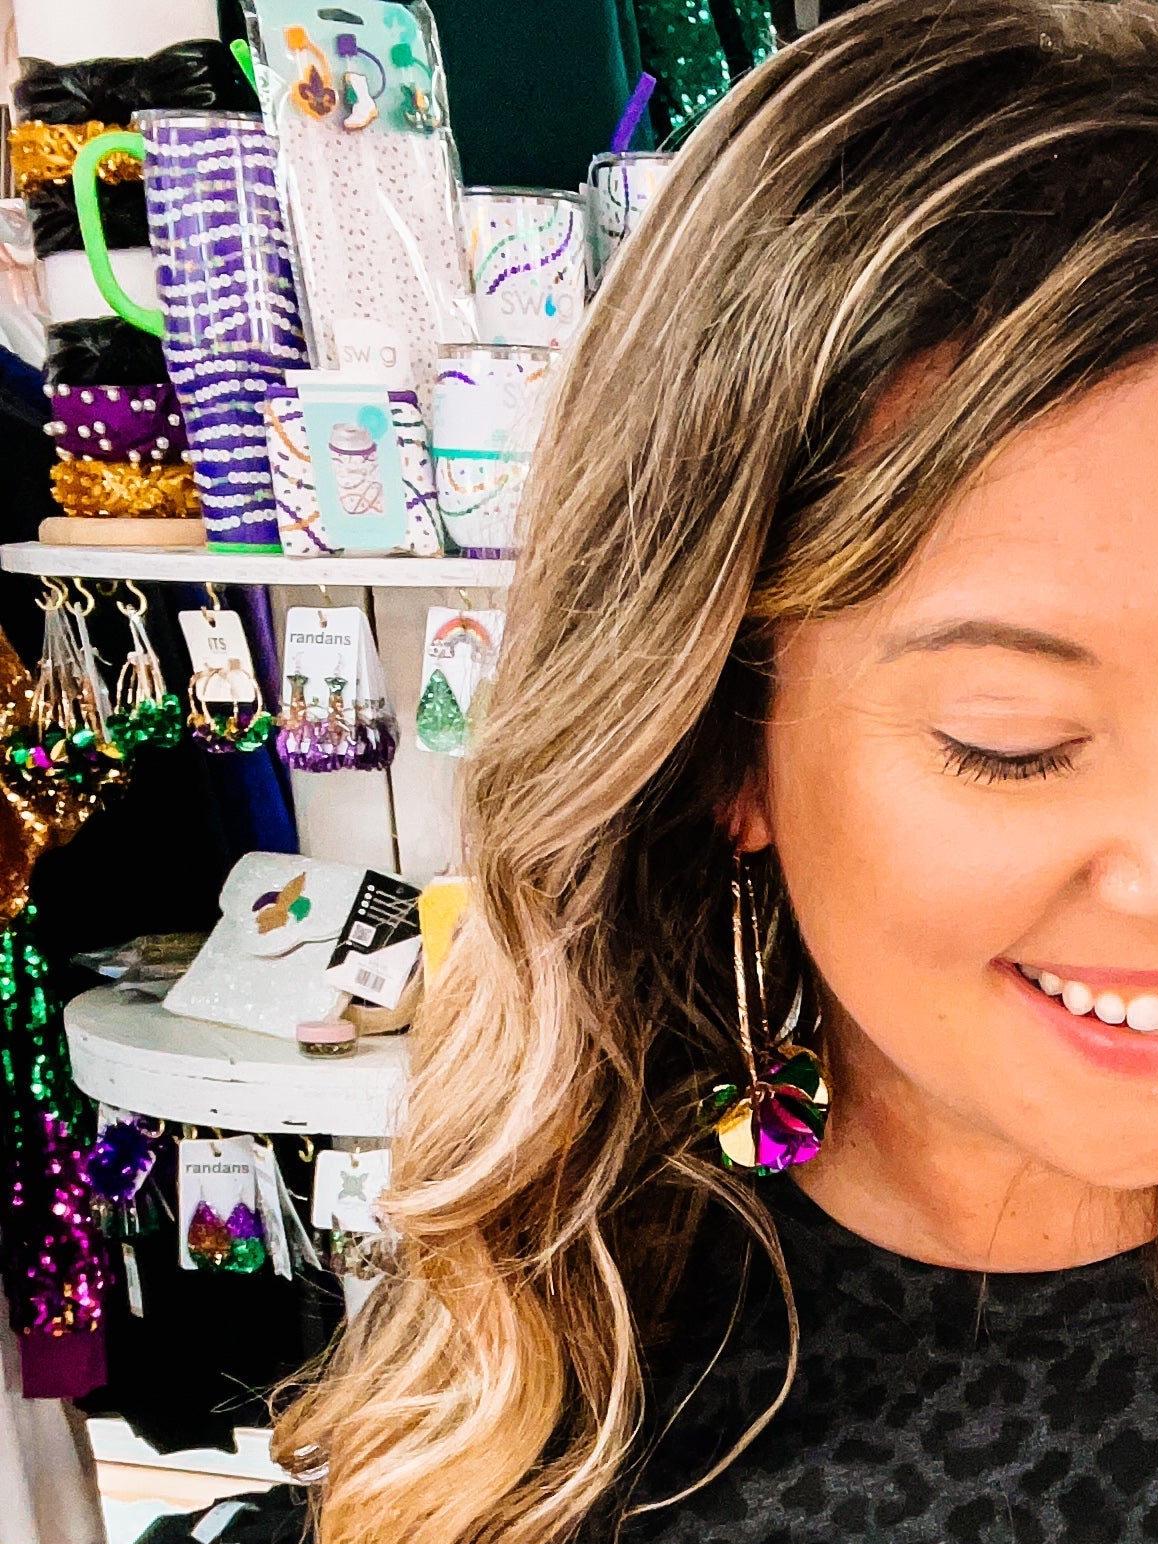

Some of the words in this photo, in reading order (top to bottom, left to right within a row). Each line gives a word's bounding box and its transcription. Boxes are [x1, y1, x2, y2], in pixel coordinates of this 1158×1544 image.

[343, 344, 397, 368] swg
[289, 631, 352, 646] randans
[185, 1162, 250, 1174] randans
